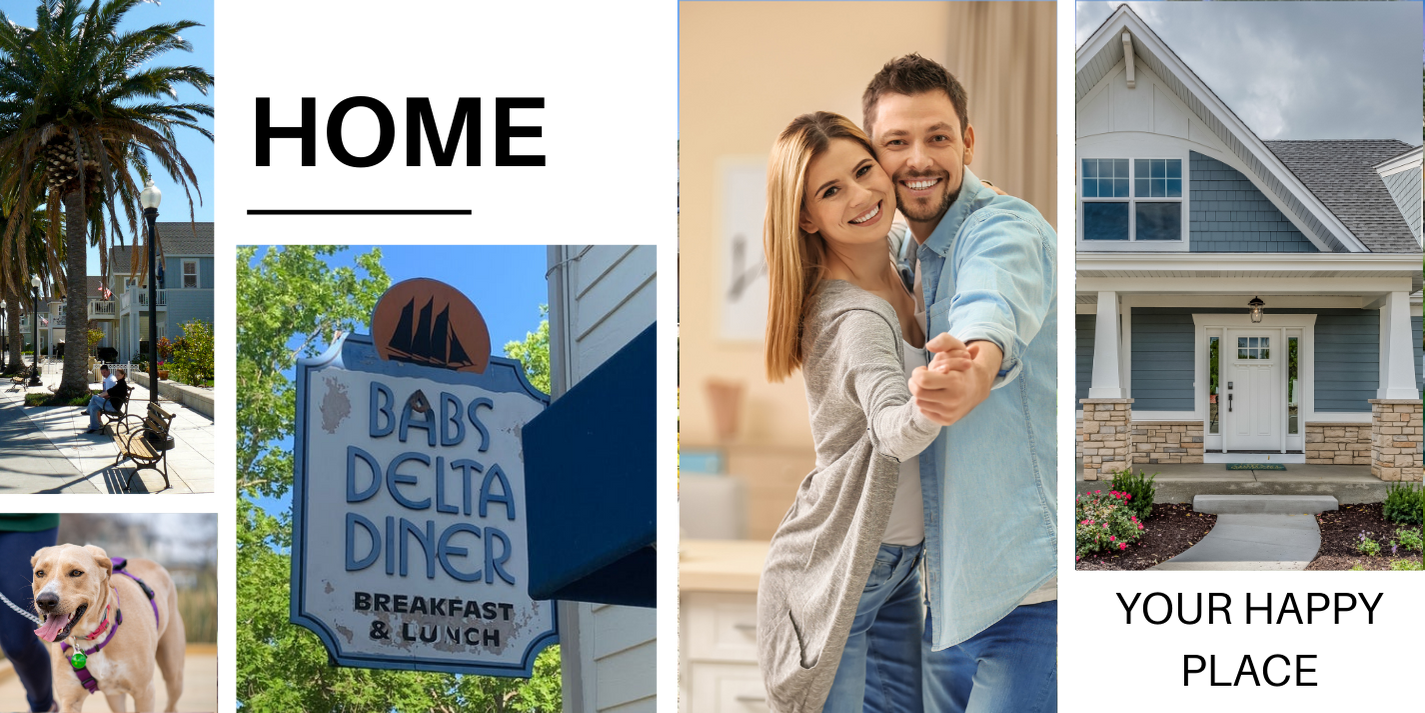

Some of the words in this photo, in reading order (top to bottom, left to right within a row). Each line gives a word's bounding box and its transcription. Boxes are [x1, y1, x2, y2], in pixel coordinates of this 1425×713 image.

[370, 381, 493, 452] BABS
[346, 446, 516, 520] DELTA
[346, 512, 516, 585] DINER
[354, 592, 513, 621] BREAKFAST
[369, 620, 390, 640] &
[403, 623, 500, 647] LUNCH
